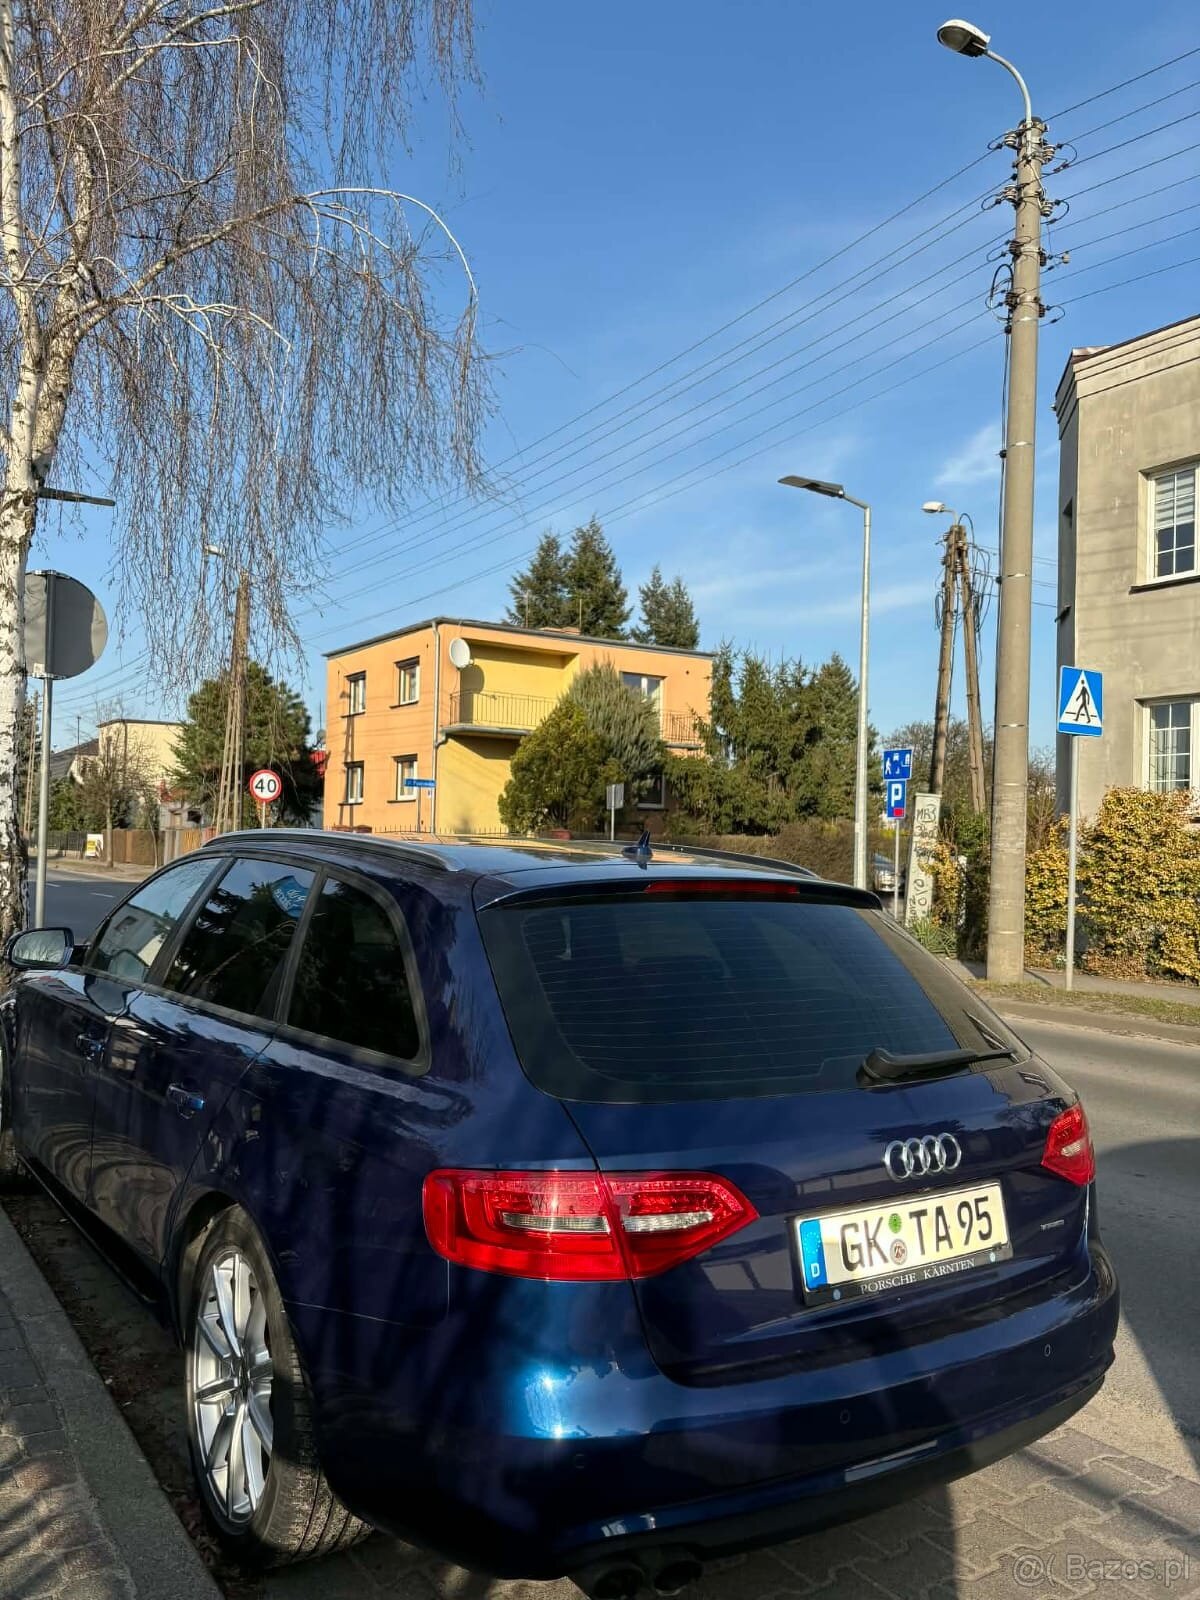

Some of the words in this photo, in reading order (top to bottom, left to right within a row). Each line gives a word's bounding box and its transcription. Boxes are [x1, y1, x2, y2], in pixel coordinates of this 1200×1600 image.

[255, 779, 277, 793] 40
[891, 783, 903, 808] P
[839, 1216, 889, 1272] GK
[810, 1261, 821, 1278] D
[860, 1271, 917, 1295] PORSCHE
[923, 1257, 976, 1280] KÄRNTEN
